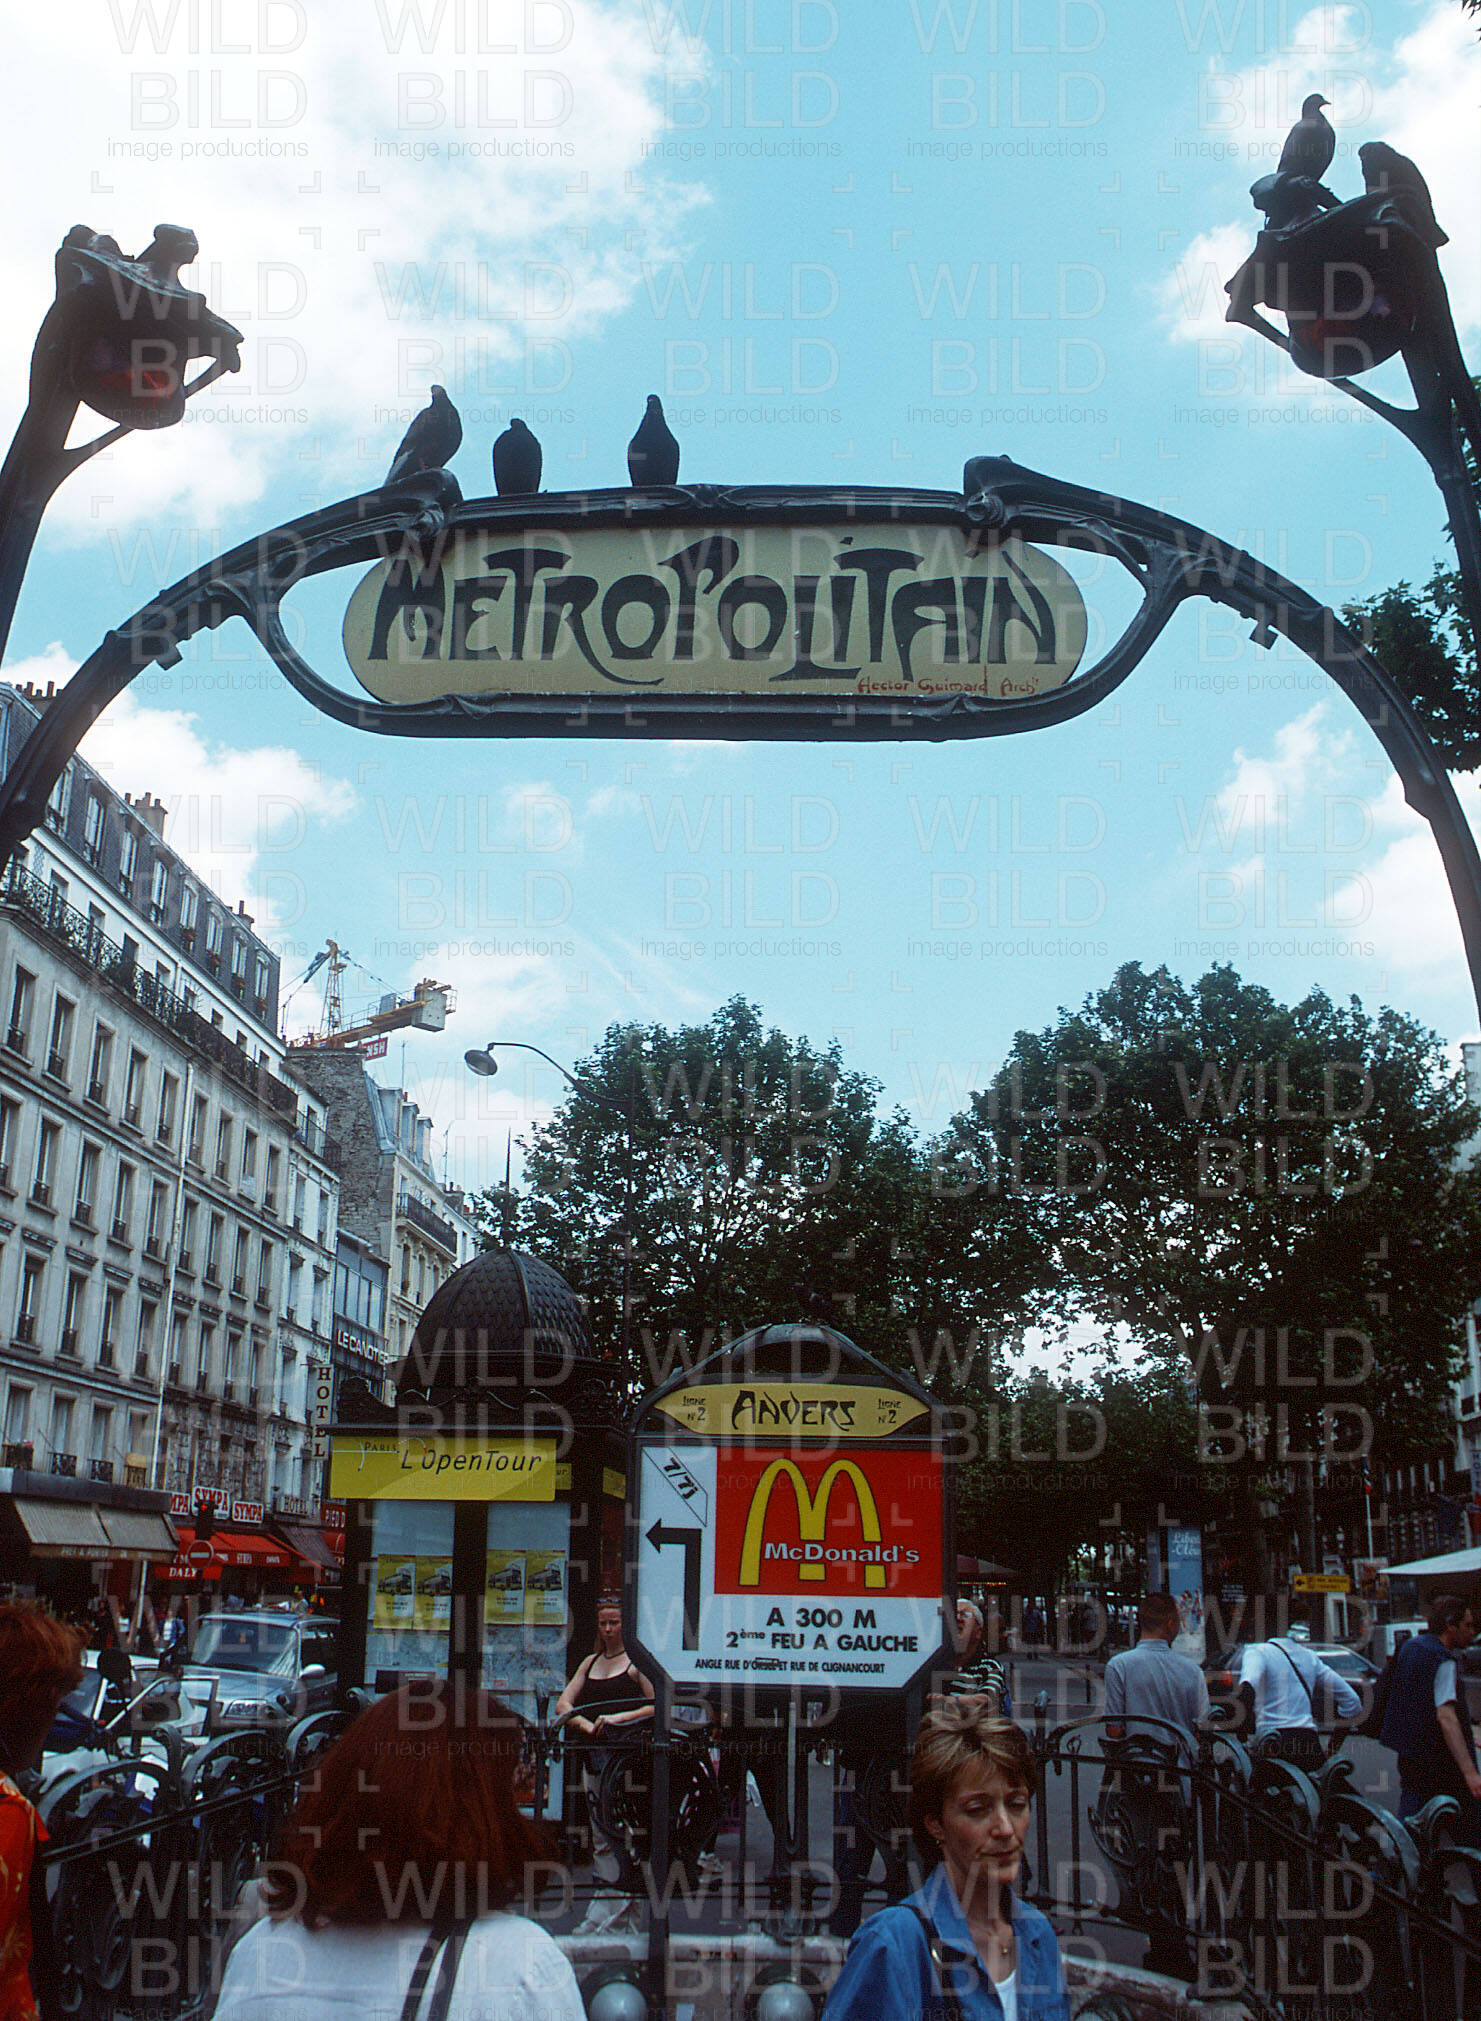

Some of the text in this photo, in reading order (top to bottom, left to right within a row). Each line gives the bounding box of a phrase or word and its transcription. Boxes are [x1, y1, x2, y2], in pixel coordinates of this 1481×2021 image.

[366, 535, 1057, 685] METROPOLITAIN
[857, 675, 910, 693] Hector
[918, 665, 988, 696] Guimard
[336, 1328, 349, 1349] LE
[314, 1366, 332, 1458] HOTEL
[731, 1389, 857, 1432] ANVERS
[234, 1503, 263, 1522] SYMPA
[284, 1496, 308, 1514] HOTEL
[764, 1542, 920, 1563] McDonald's
[766, 1608, 877, 1629] A 300 M
[726, 1628, 918, 1653] 2ème FEU A GAUCHE
[695, 1659, 722, 1670] ANGLE
[724, 1659, 741, 1670] RUE
[779, 1661, 788, 1671] ET
[790, 1661, 807, 1672] RUE
[808, 1661, 819, 1672] DE
[822, 1661, 885, 1674] CLIGNANCOURT
